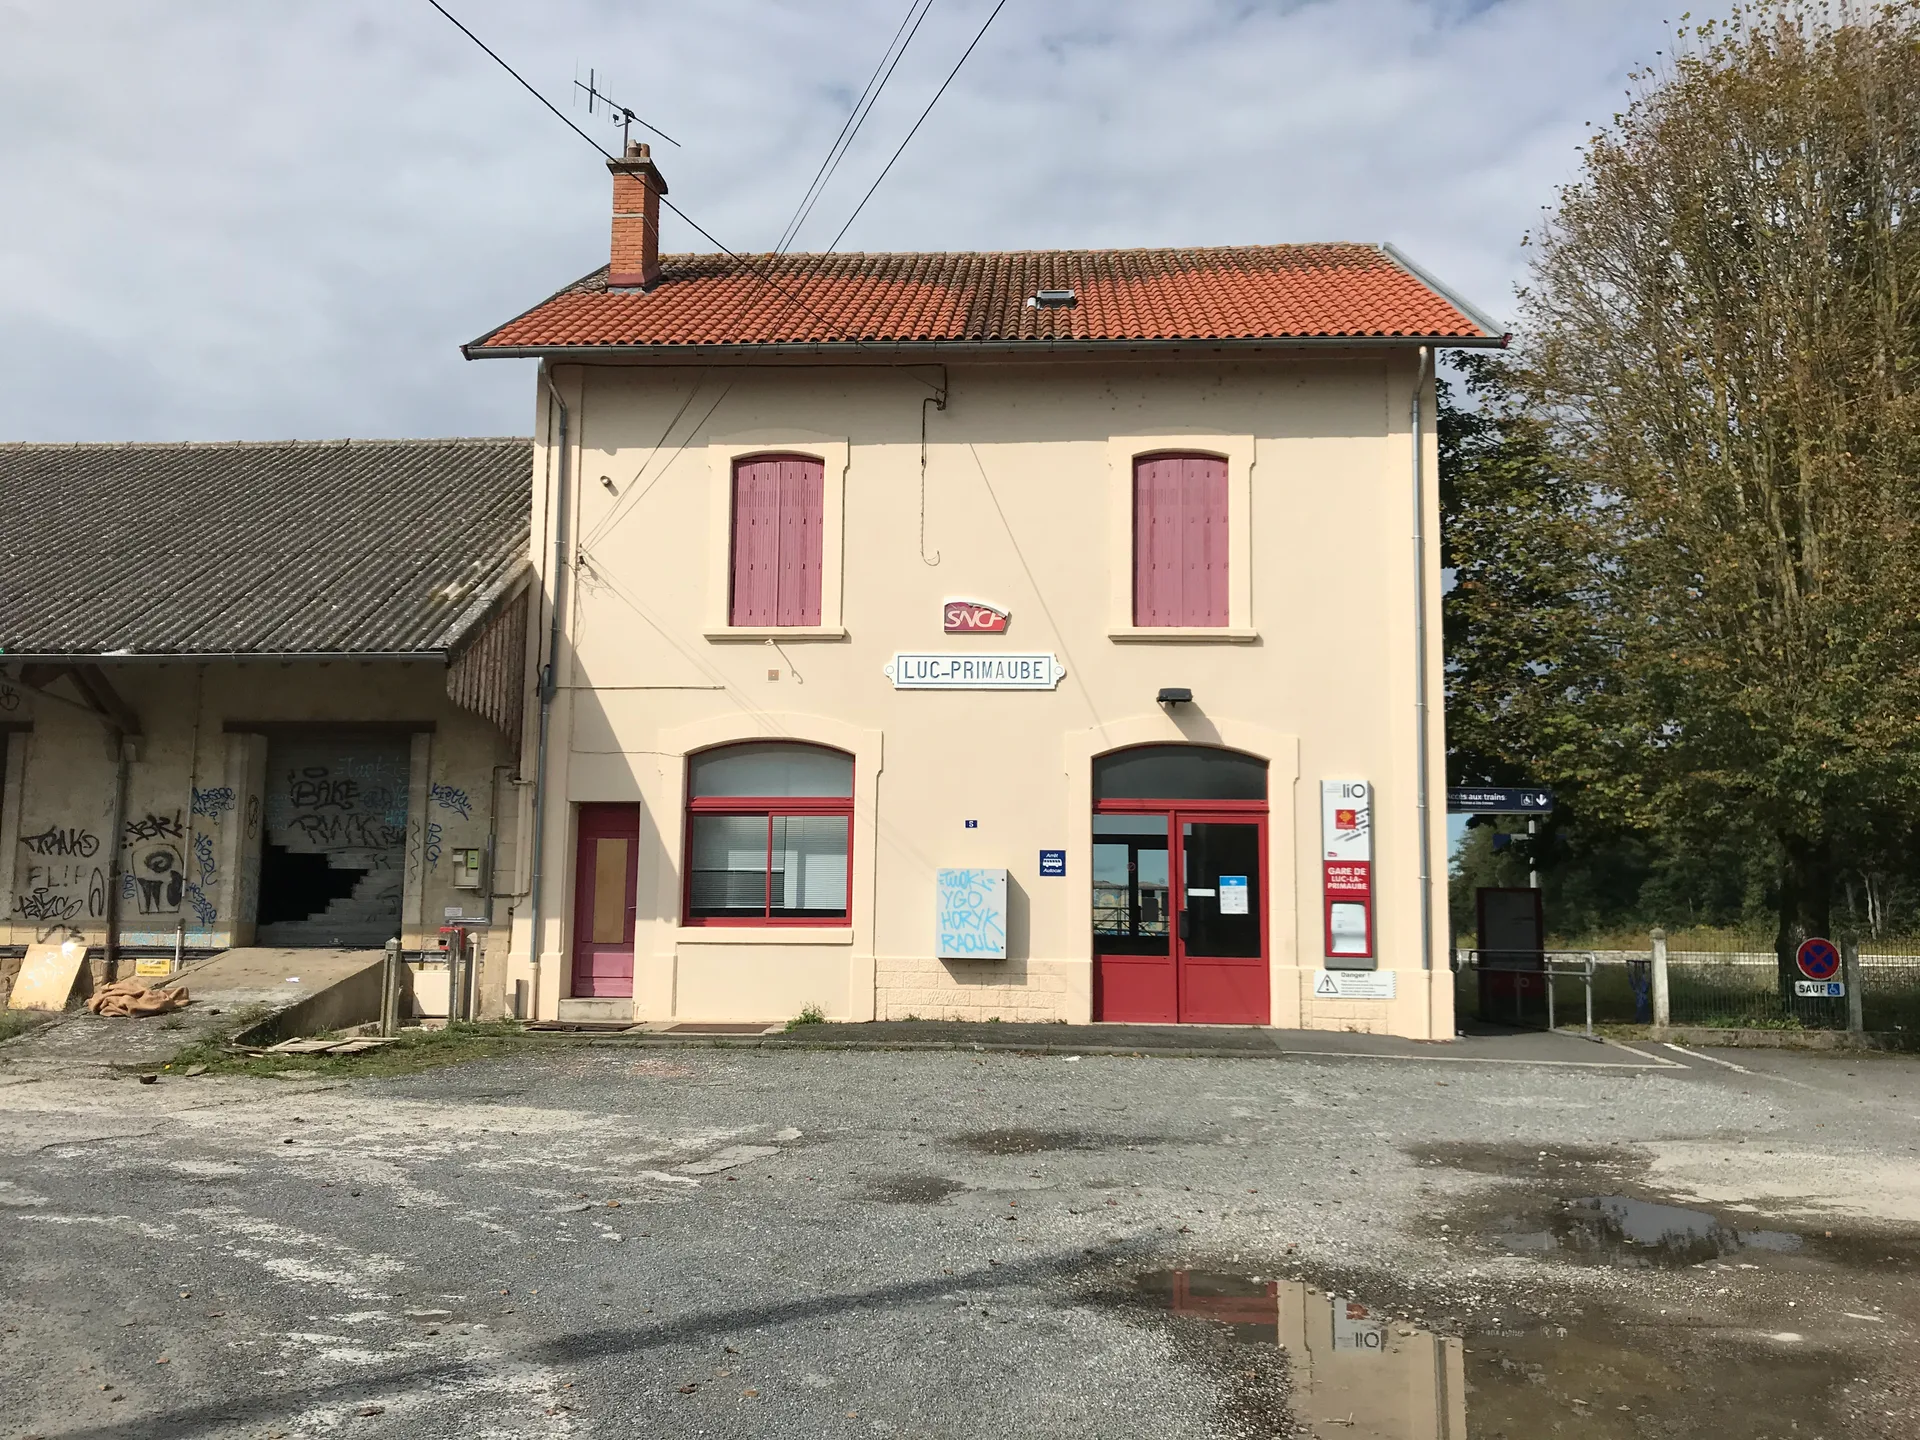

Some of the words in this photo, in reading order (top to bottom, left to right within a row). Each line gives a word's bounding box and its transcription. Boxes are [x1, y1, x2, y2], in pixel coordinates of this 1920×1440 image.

[1468, 793, 1483, 801] aux
[1483, 793, 1506, 801] trains
[1327, 867, 1353, 875] GARE
[1354, 867, 1367, 876] DE
[1327, 882, 1368, 890] PRIMAUBE
[1798, 984, 1826, 993] SAUF
